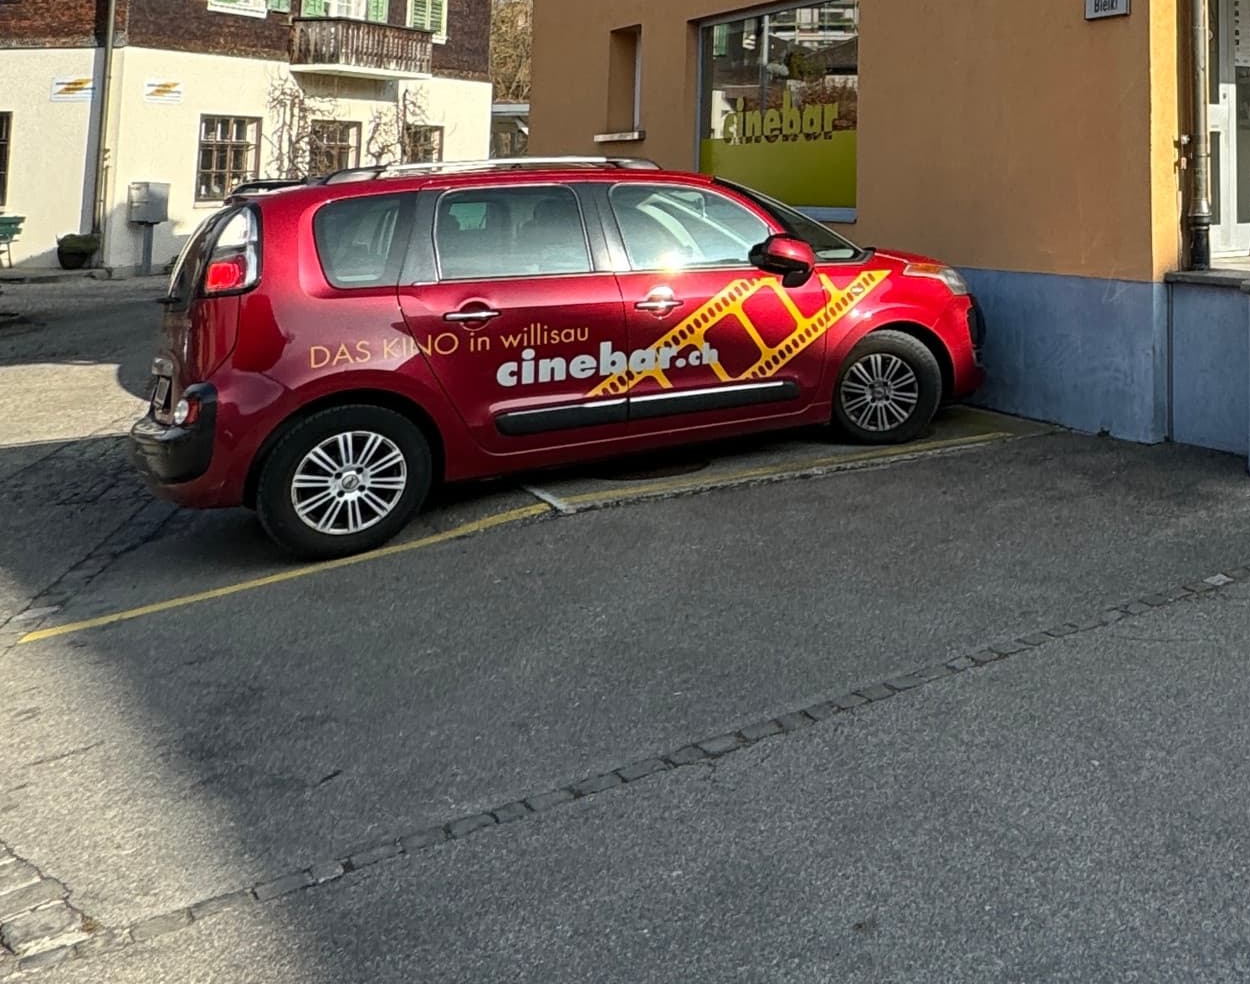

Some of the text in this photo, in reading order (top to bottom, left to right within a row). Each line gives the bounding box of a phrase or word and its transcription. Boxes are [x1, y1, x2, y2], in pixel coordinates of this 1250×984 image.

[723, 89, 839, 144] cinebar
[309, 323, 589, 370] DAS KINO in willisau
[496, 340, 719, 387] cinebar.ch
